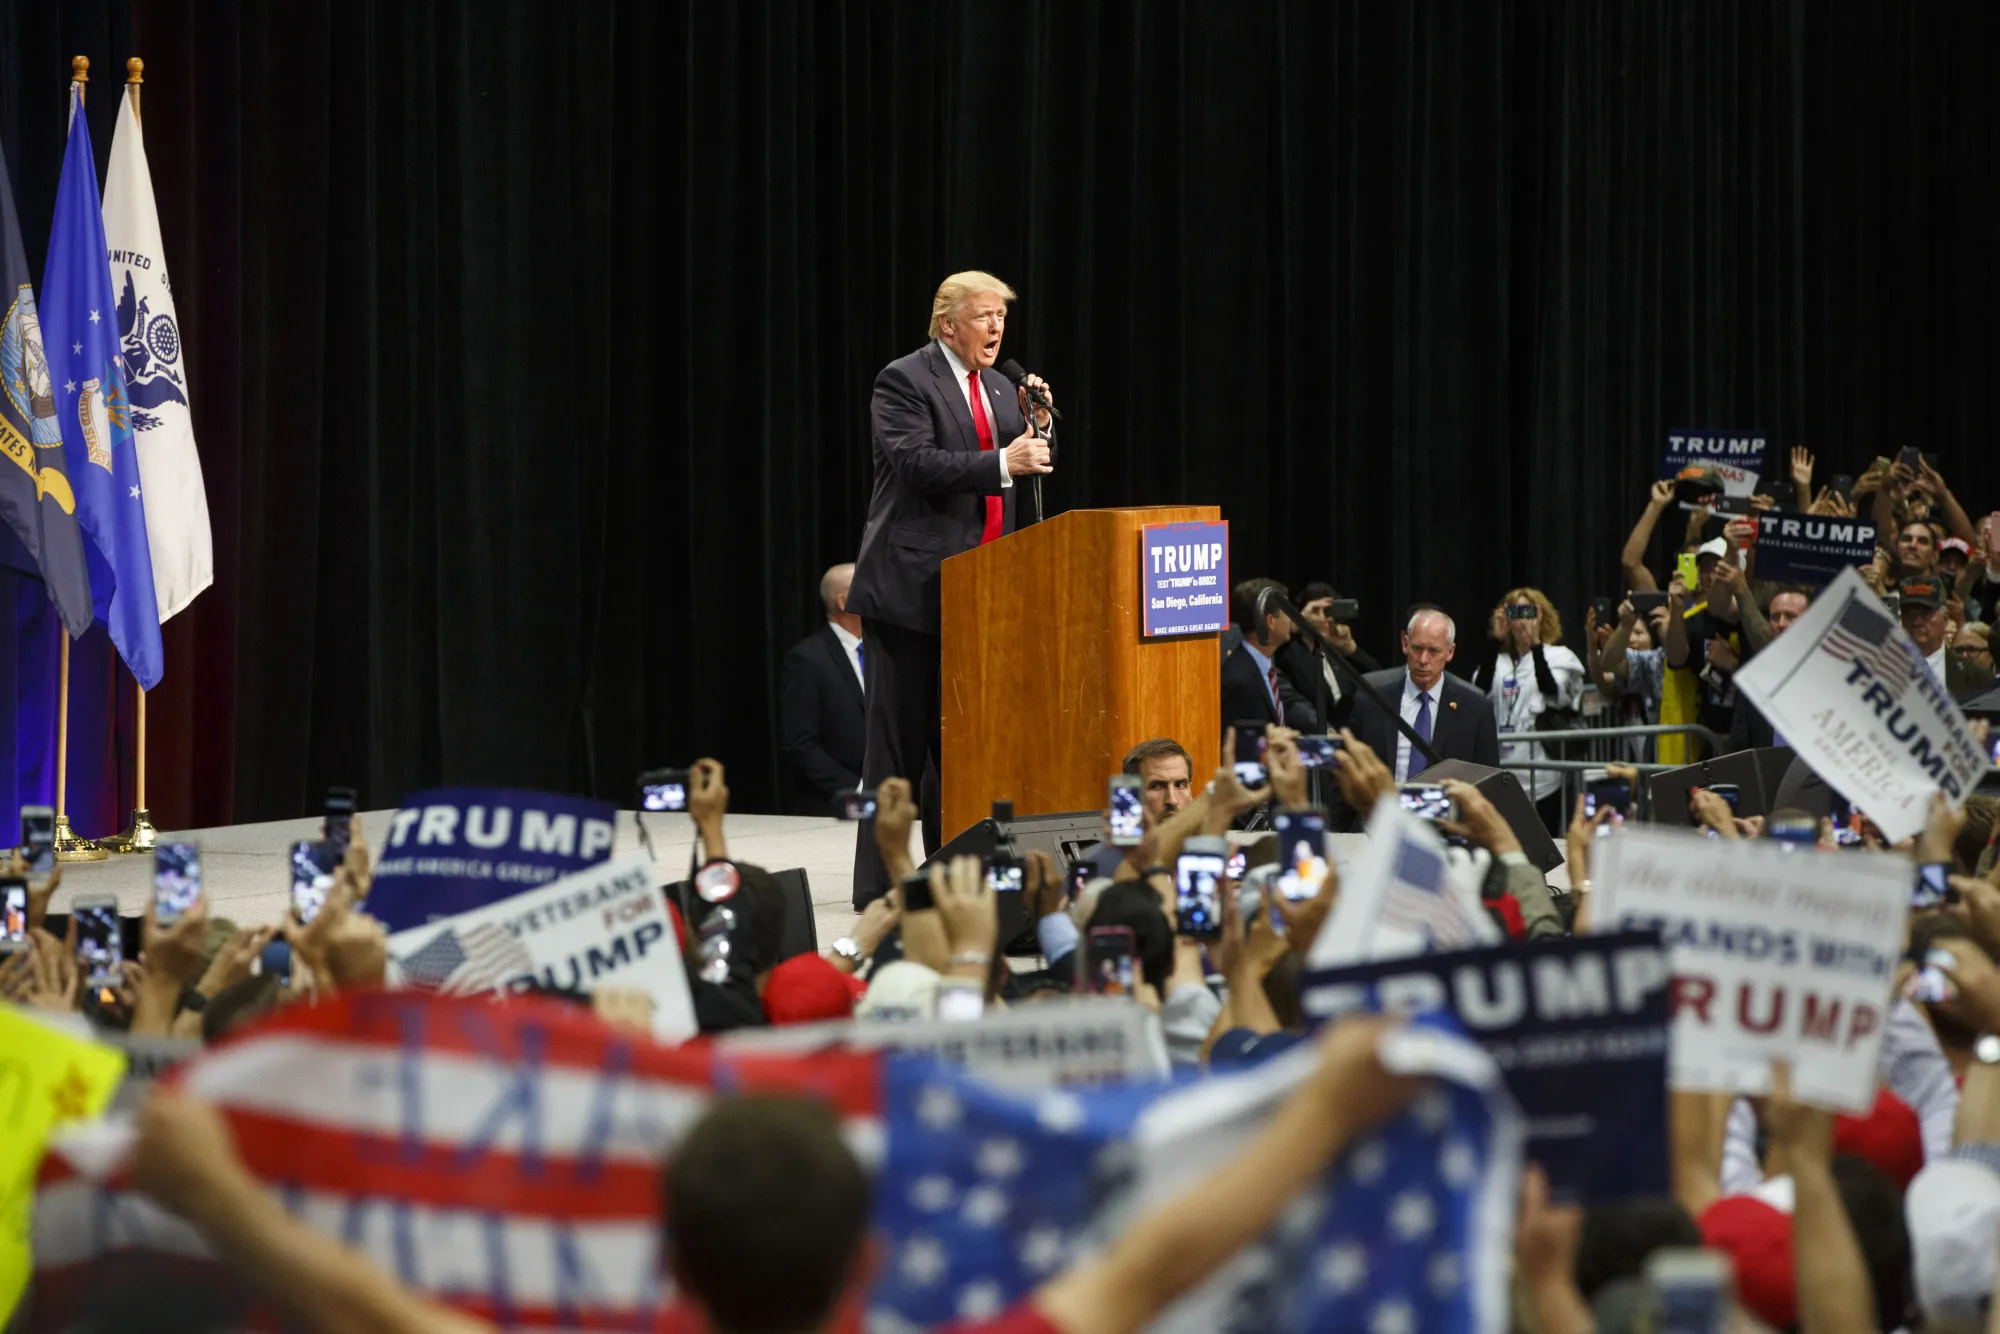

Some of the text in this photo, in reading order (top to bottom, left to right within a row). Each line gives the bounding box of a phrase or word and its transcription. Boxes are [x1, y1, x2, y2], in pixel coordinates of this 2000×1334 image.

[0, 420, 26, 457] ATES
[1669, 436, 1766, 454] TRUMP
[1759, 537, 1781, 548] MAKE
[1782, 540, 1817, 552] AMERICA
[1819, 544, 1844, 555] GREAT
[1761, 517, 1875, 543] TRUMP
[1151, 543, 1222, 573] TRUMP
[1157, 580, 1168, 588] TEXT
[1151, 593, 1223, 610] San Diego, California
[1168, 625, 1188, 633] AMERICA
[1845, 657, 1961, 800] TRUMP
[389, 805, 615, 860] TRUMP
[504, 868, 649, 938] VETERANS
[603, 895, 653, 931] FOR
[508, 921, 664, 992] UMP
[1668, 973, 1878, 1050] RUMP
